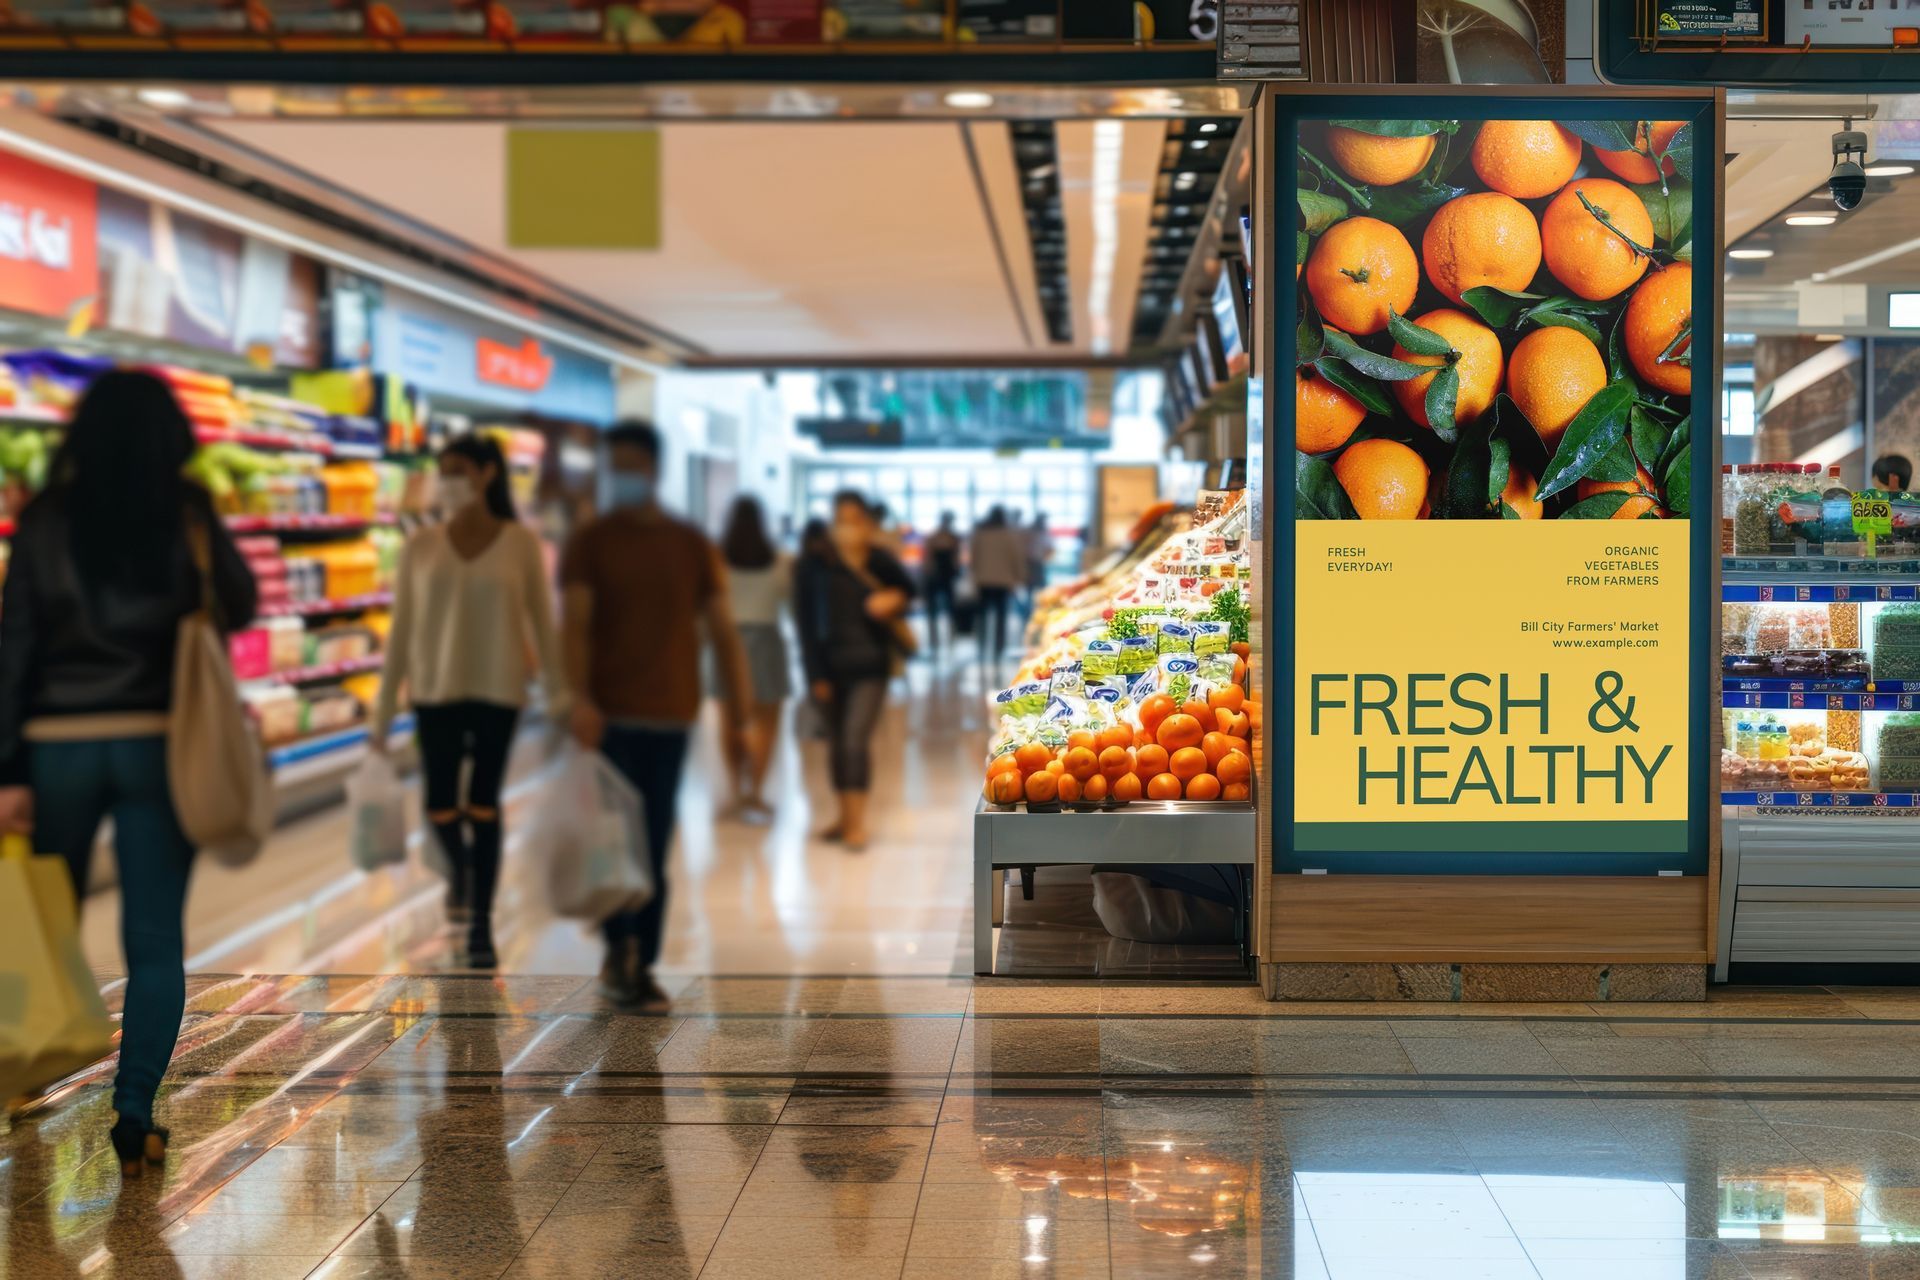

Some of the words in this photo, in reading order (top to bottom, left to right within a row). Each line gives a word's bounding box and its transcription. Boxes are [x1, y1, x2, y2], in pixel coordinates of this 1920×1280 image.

[1327, 547, 1366, 558] FRESH
[1604, 545, 1659, 556] ORGANIC
[1327, 561, 1393, 572] EVERYDAY!
[1584, 560, 1659, 571] VEGETABLES
[1566, 575, 1600, 586] FROM
[1603, 575, 1659, 586] FARMERS
[1520, 620, 1539, 632] Bill
[1541, 620, 1565, 635] City
[1567, 620, 1617, 632] Farmers'
[1620, 620, 1660, 632] Market
[1552, 637, 1659, 651] www.example.com
[1310, 672, 1549, 735] FRESH
[1588, 670, 1640, 733] &
[1358, 744, 1673, 805] HEALTHY
